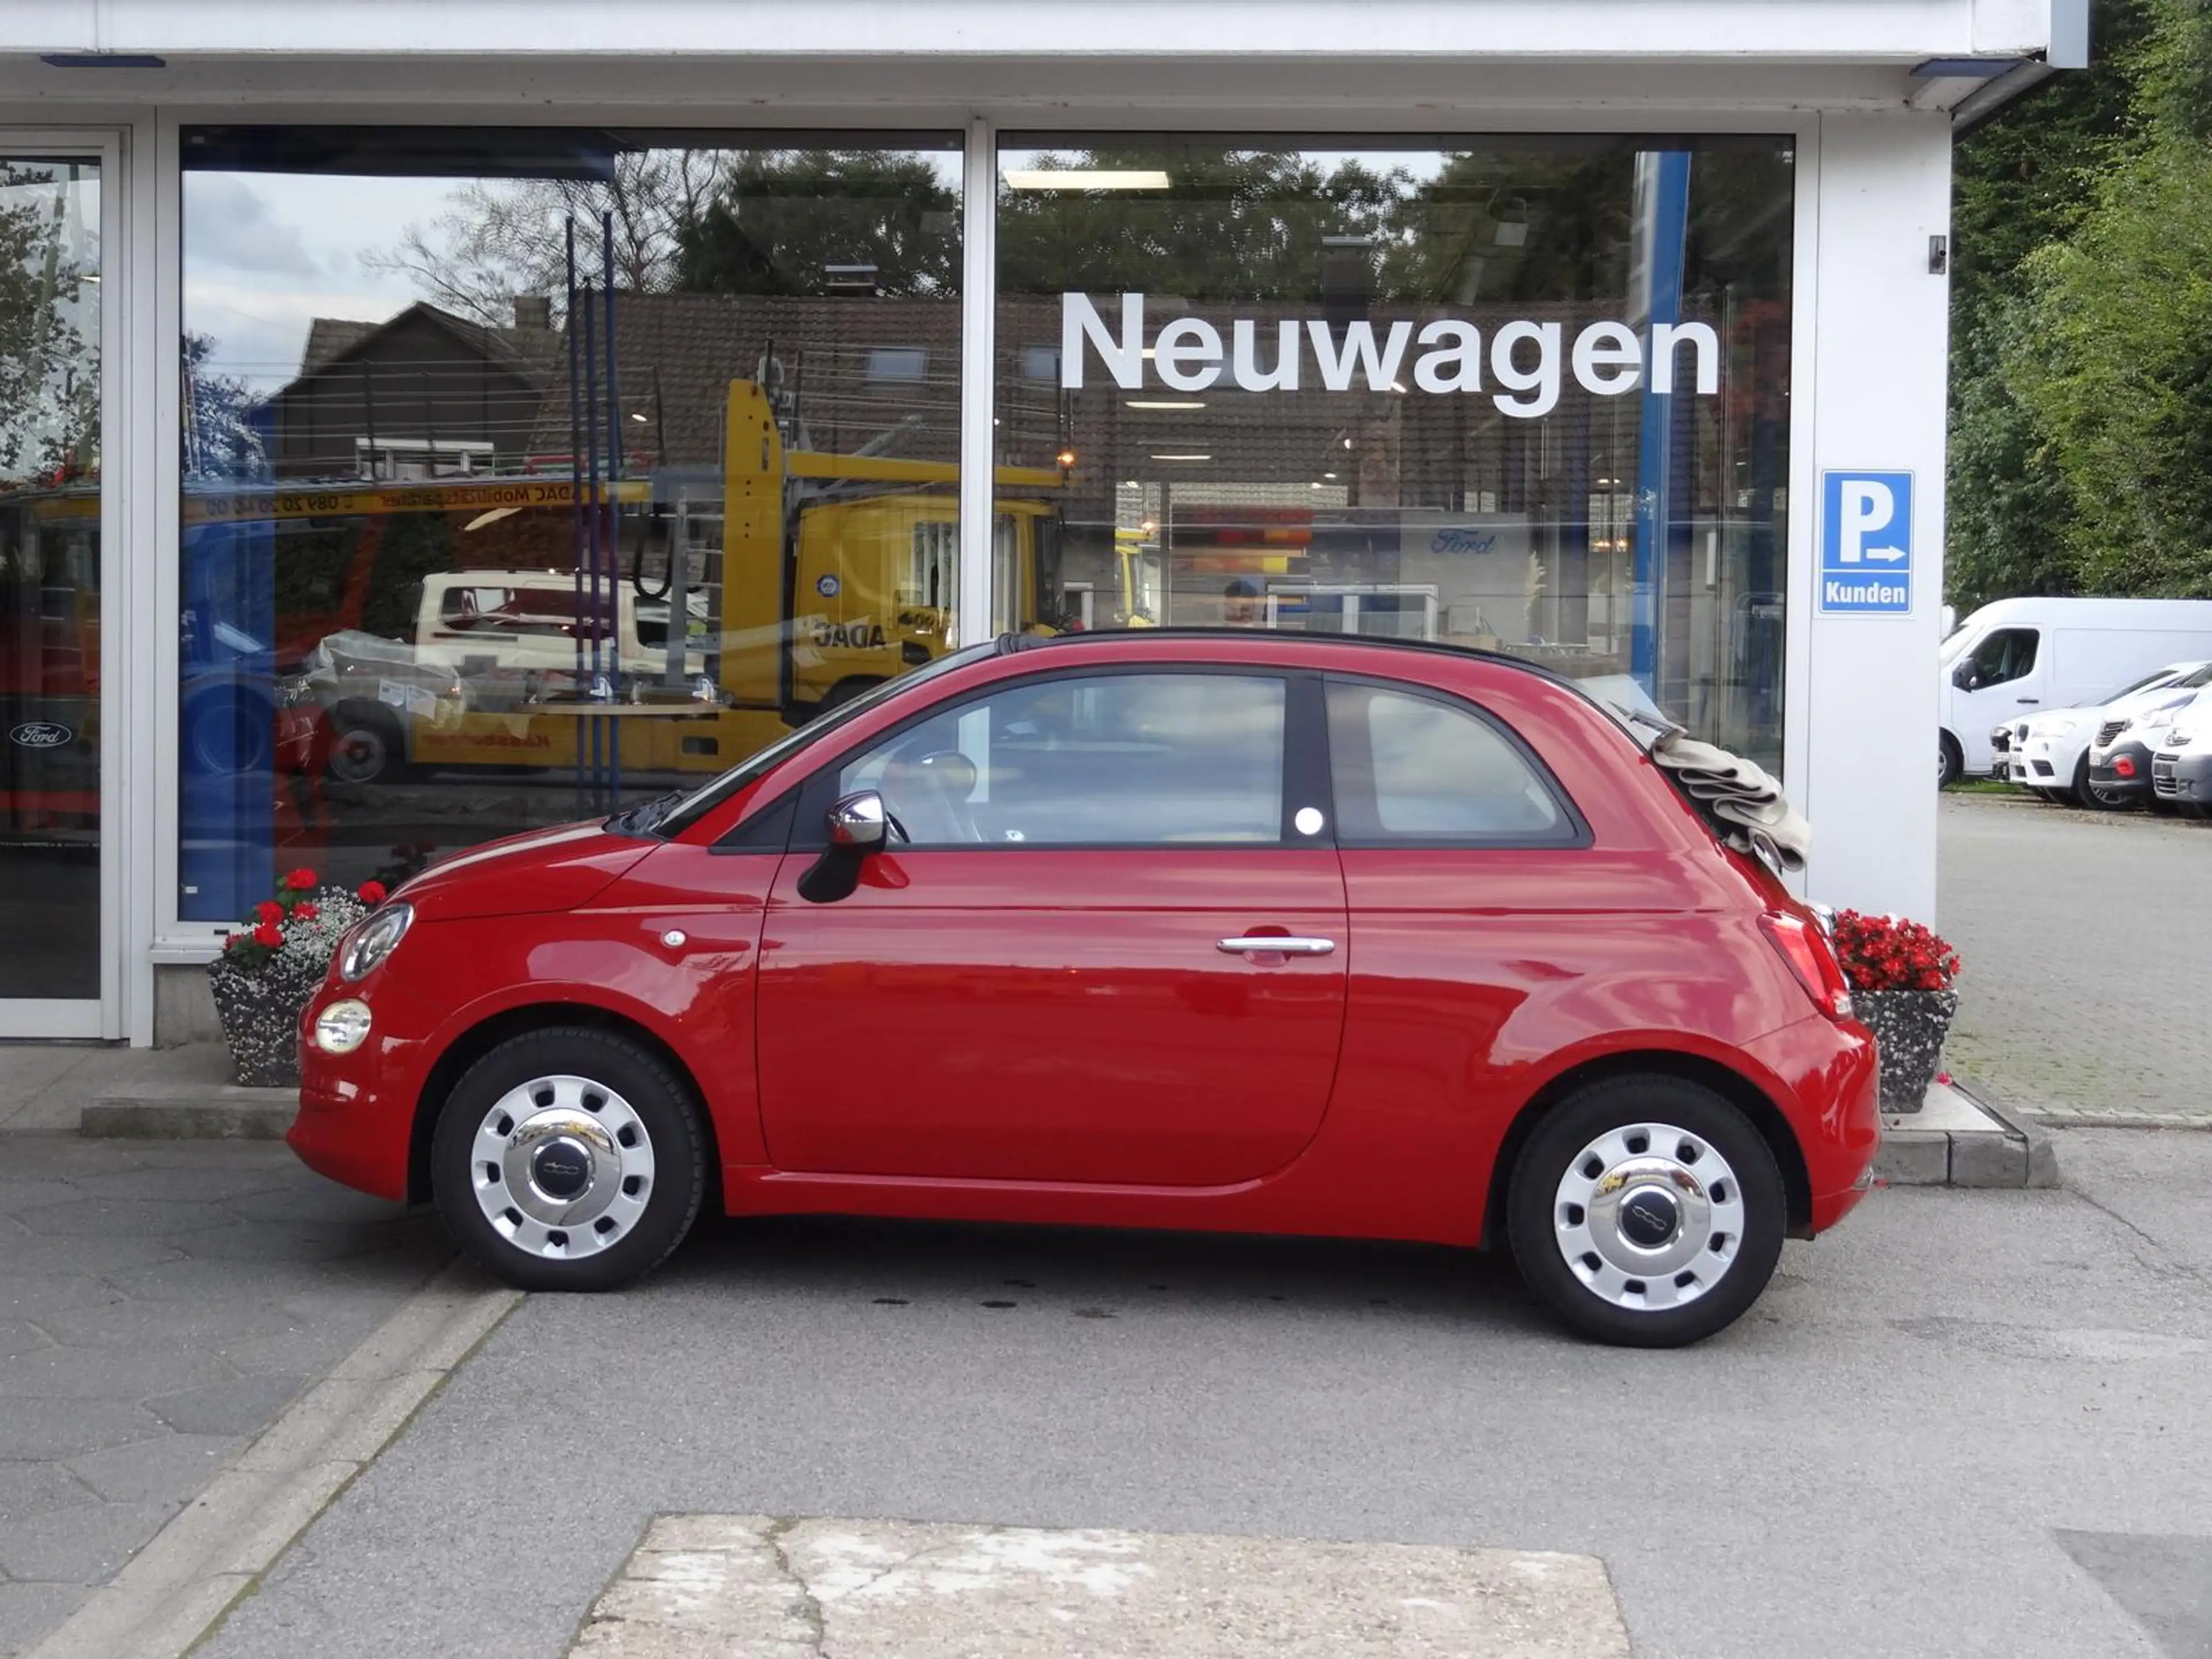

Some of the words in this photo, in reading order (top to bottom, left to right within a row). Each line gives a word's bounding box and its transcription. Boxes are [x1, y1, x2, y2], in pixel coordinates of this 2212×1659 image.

[1062, 292, 1718, 418] Neuwagen
[1840, 480, 1894, 563] P
[1431, 528, 1497, 554] Ford
[1825, 581, 1906, 604] Kunden
[20, 726, 60, 743] Ford
